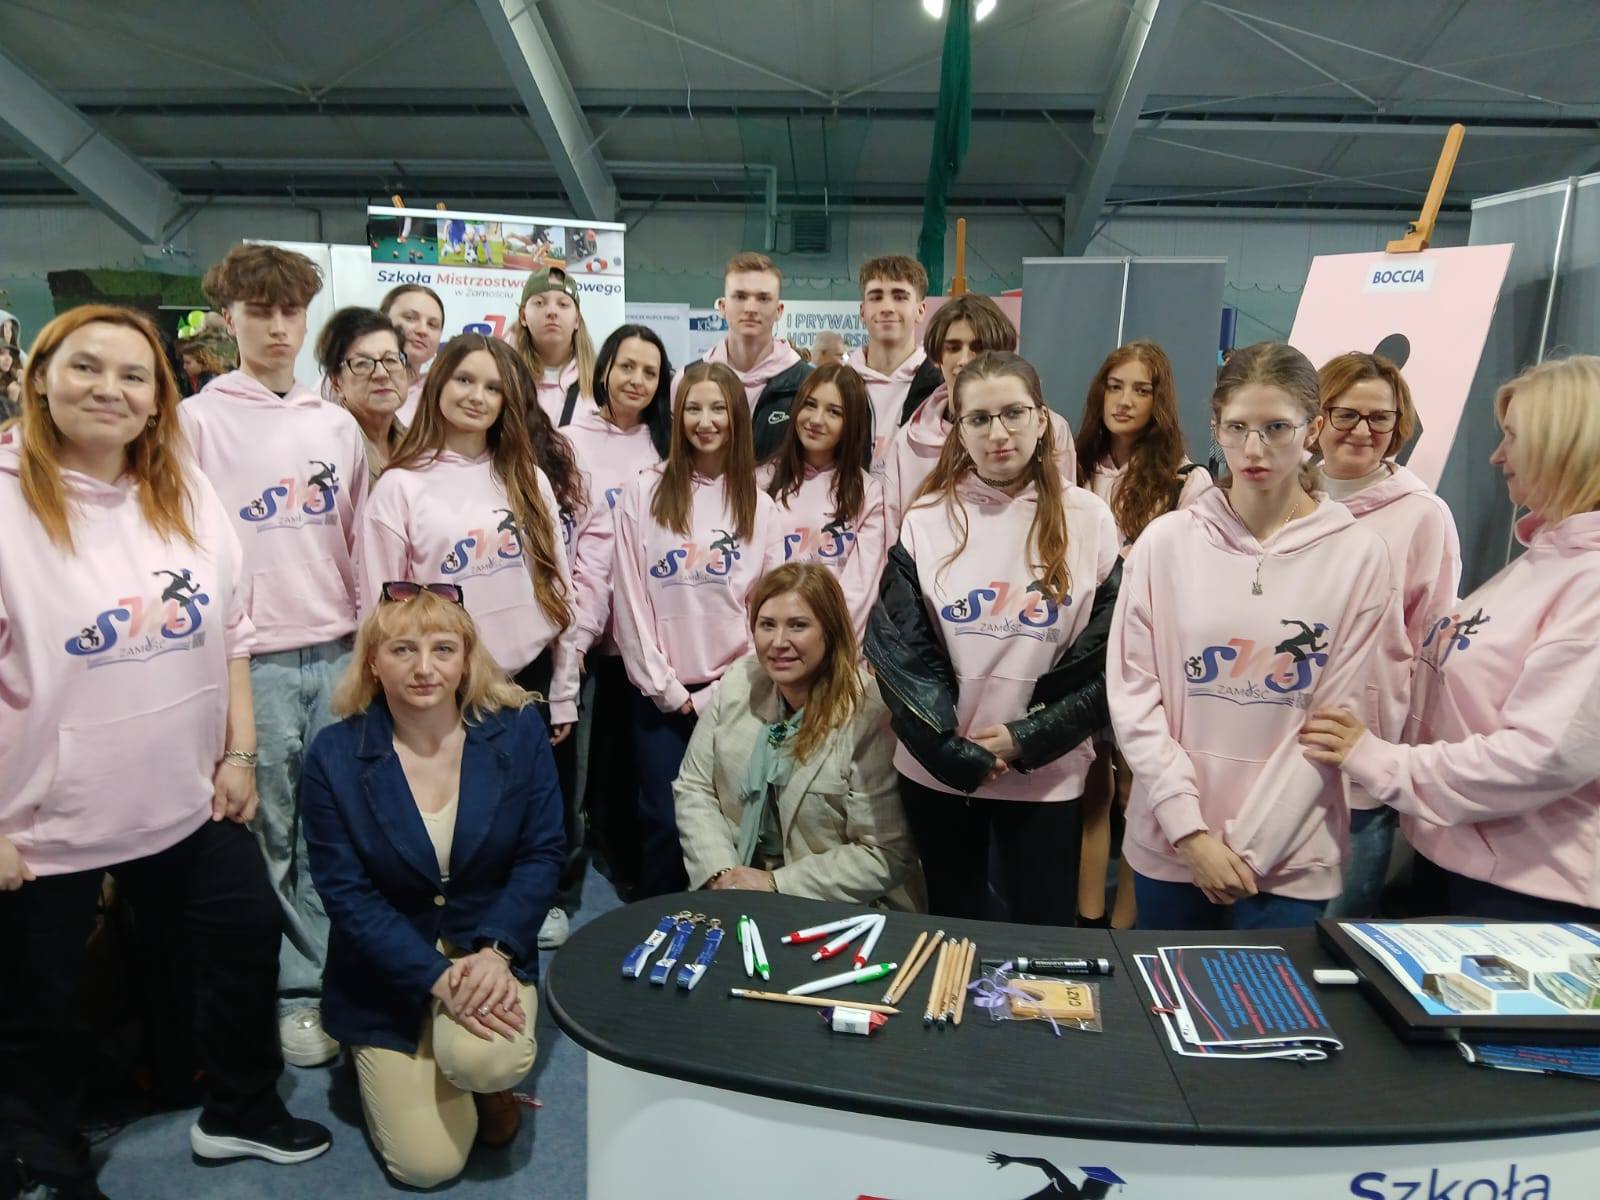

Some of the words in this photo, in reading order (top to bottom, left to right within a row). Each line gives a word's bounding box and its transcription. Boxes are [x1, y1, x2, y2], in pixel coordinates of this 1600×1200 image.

[377, 270, 432, 284] Szkoła
[1373, 269, 1424, 284] BOCCIA
[454, 289, 464, 297] w
[795, 313, 867, 330] PRYWAT
